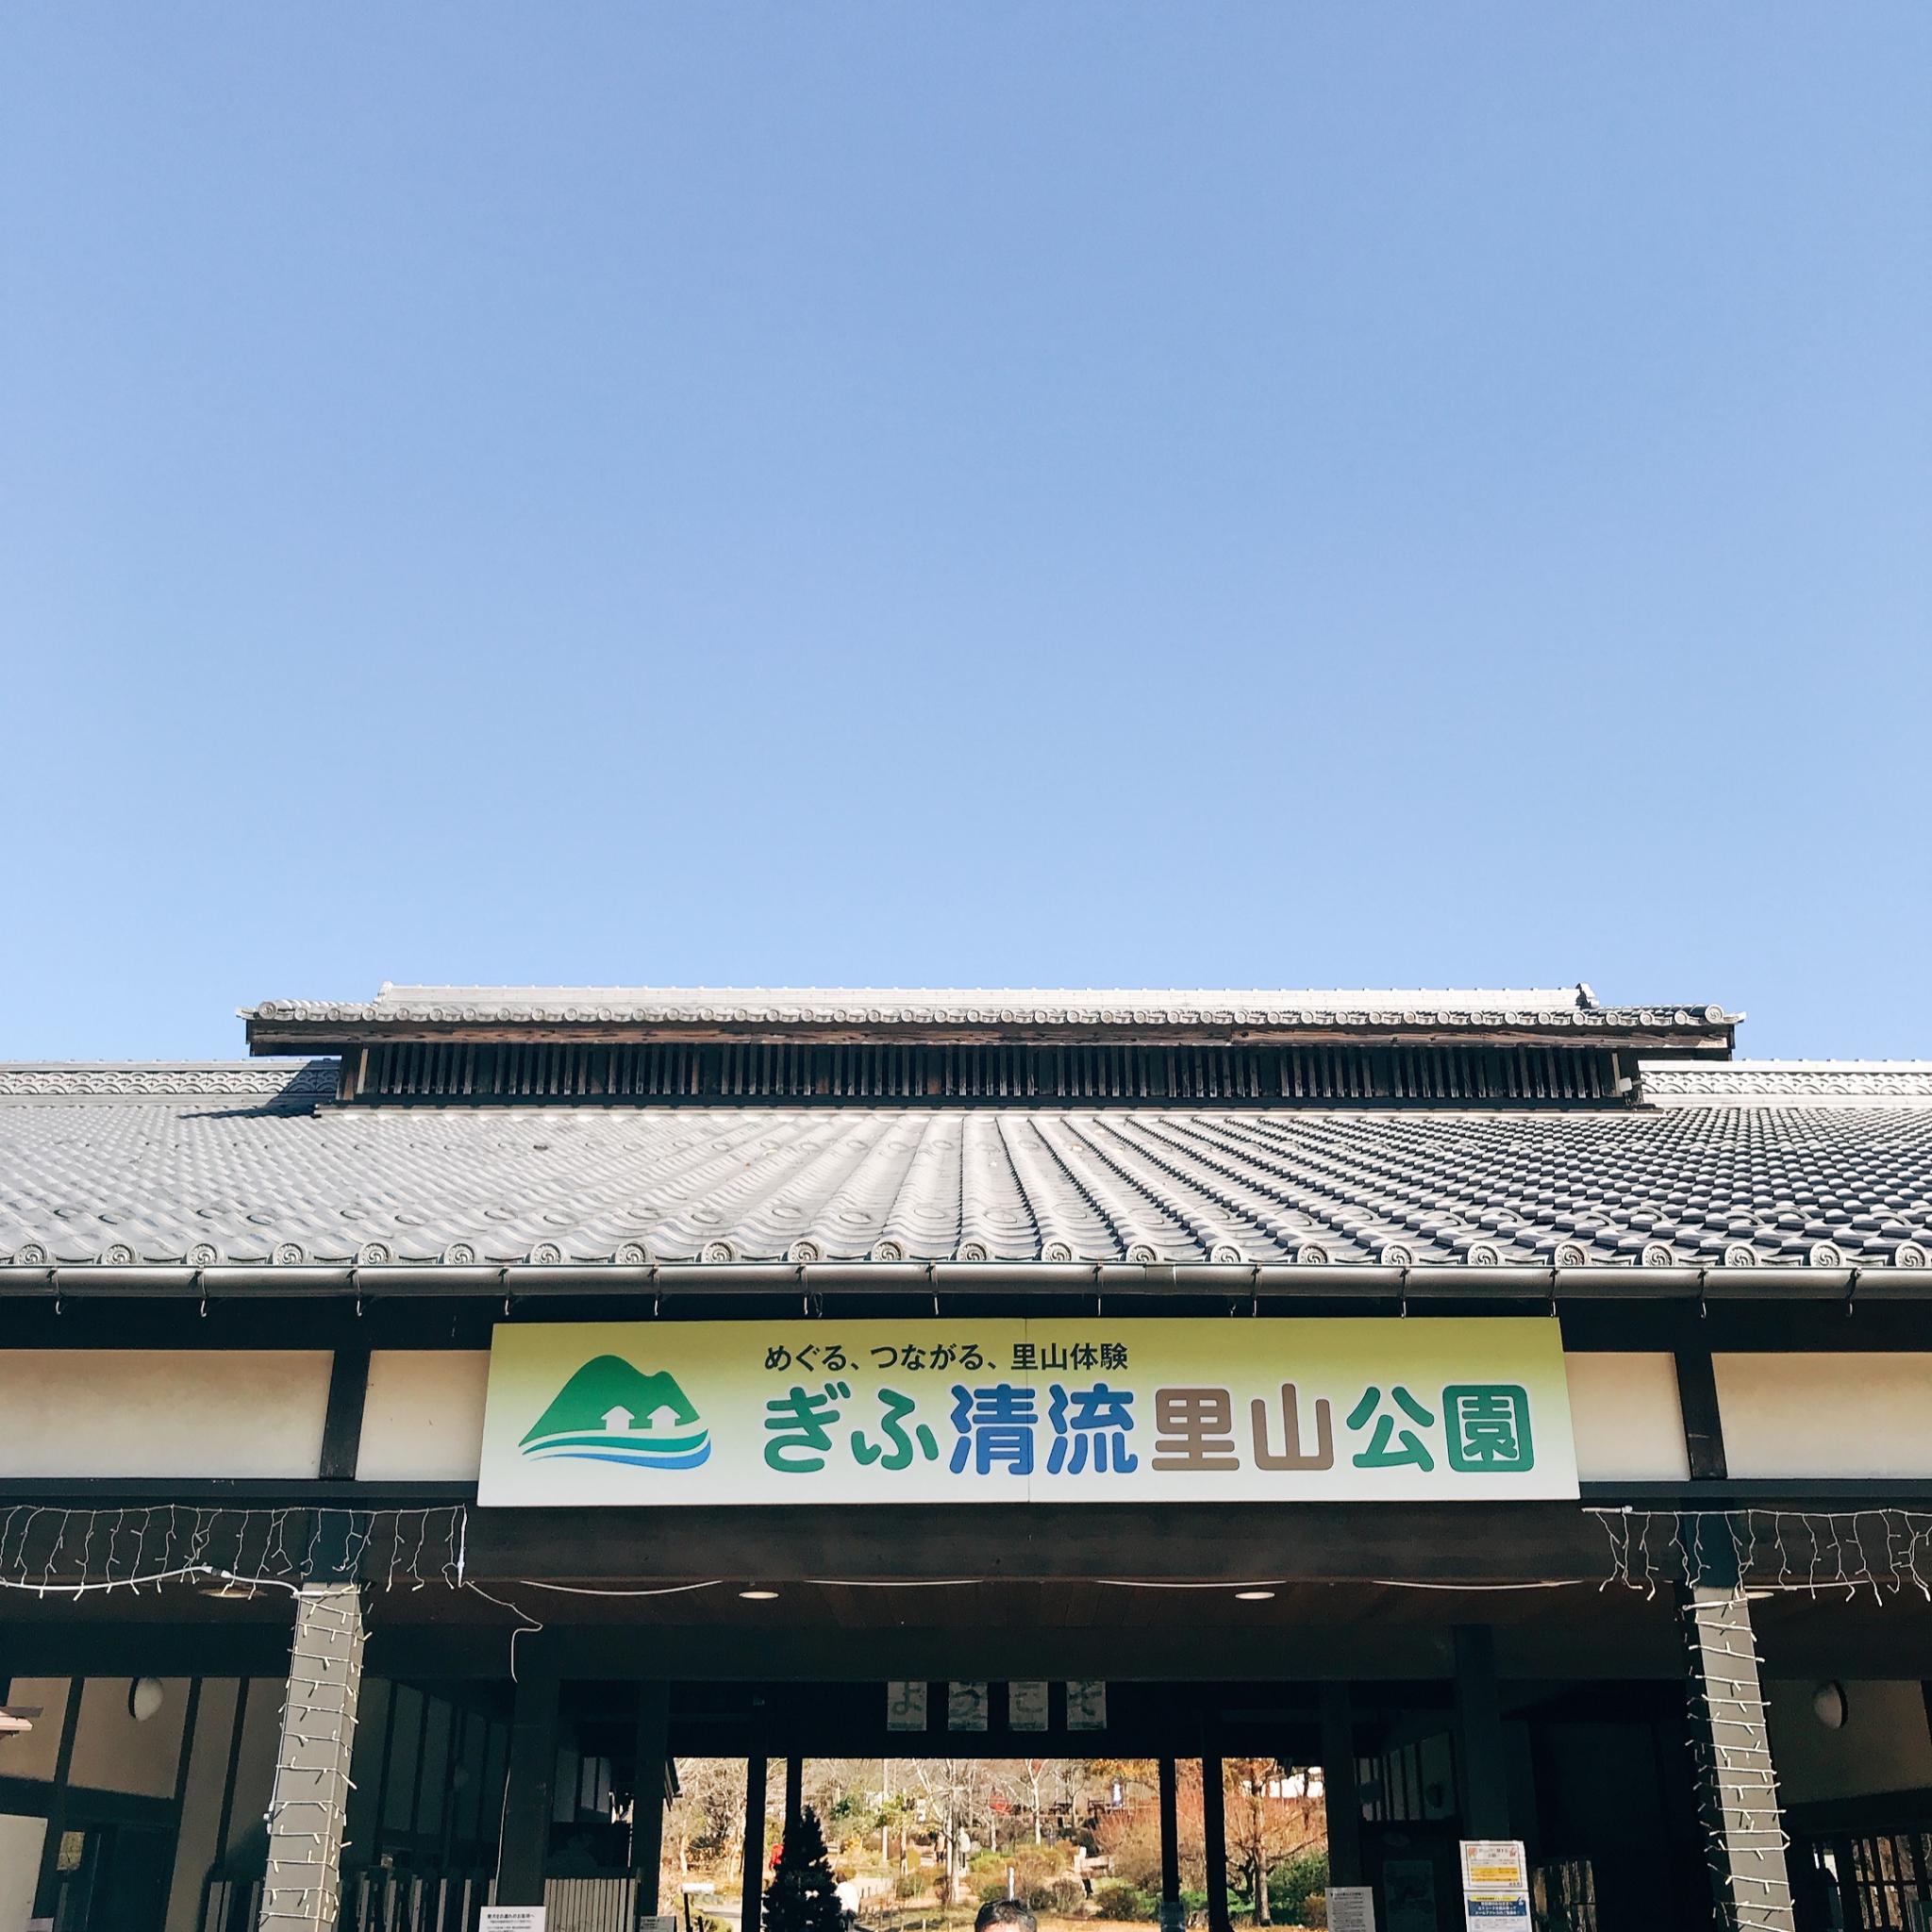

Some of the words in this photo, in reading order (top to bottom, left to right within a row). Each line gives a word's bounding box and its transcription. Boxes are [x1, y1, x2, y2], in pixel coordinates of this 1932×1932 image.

[764, 1342, 1128, 1372] めぐる、つながる、里山体験
[764, 1381, 1535, 1474] ぎふ清流里山公園
